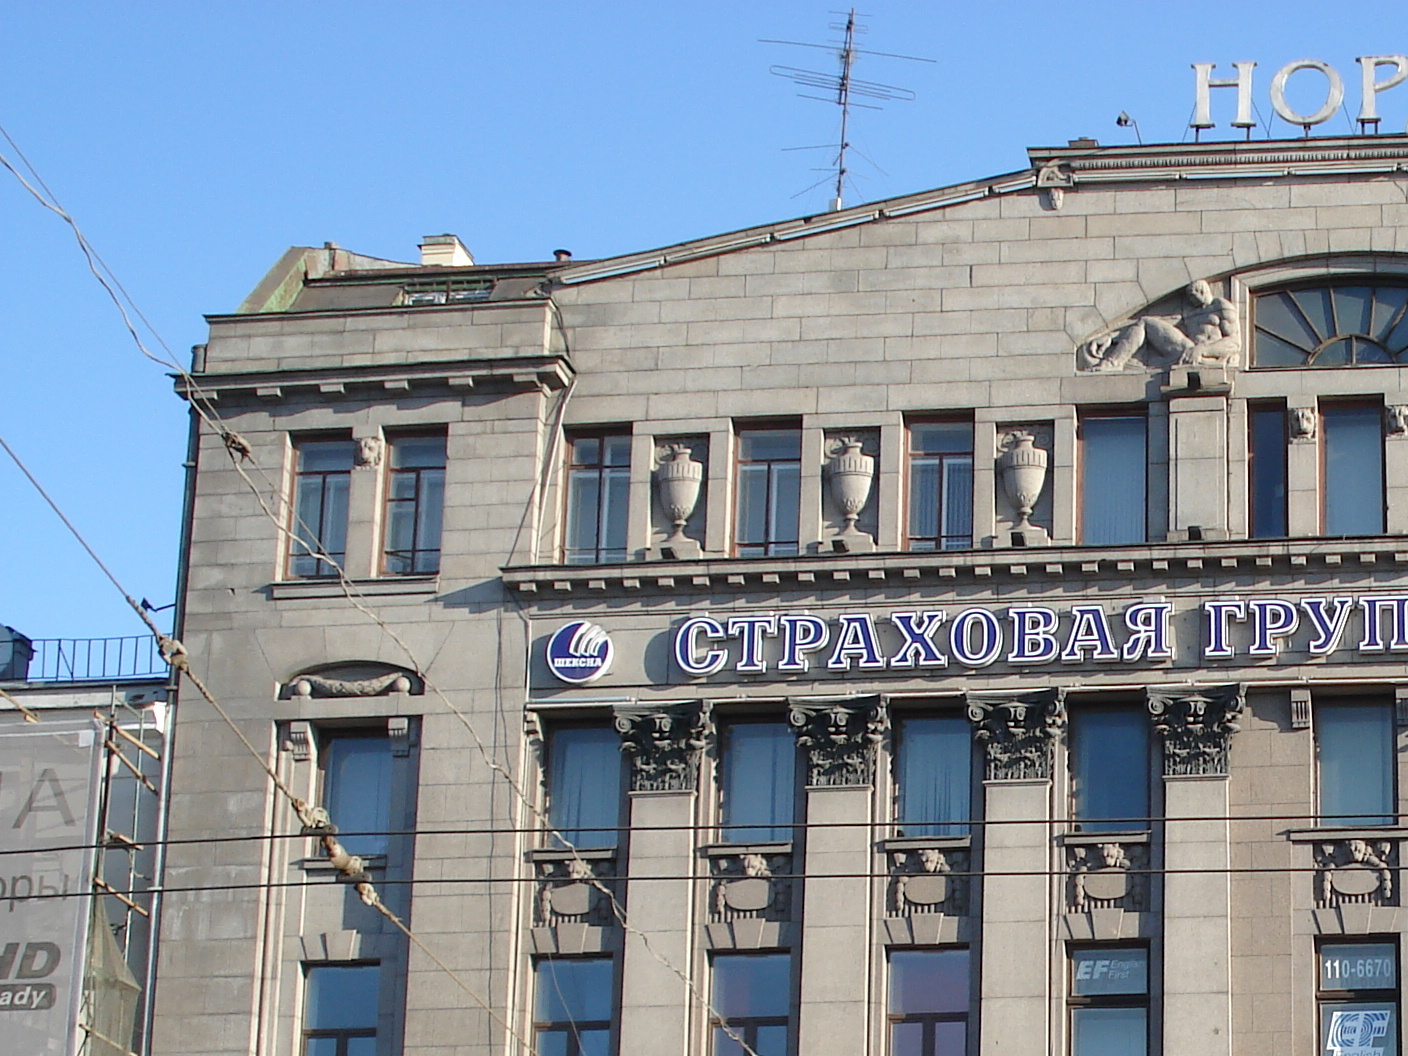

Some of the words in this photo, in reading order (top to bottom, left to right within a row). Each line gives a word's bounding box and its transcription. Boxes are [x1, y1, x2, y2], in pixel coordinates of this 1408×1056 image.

[675, 599, 1174, 678] СТРАХОВАЯ
[553, 657, 603, 668] ШЕКСНА
[1075, 959, 1111, 980] EF
[1325, 959, 1390, 979] 110-6670
